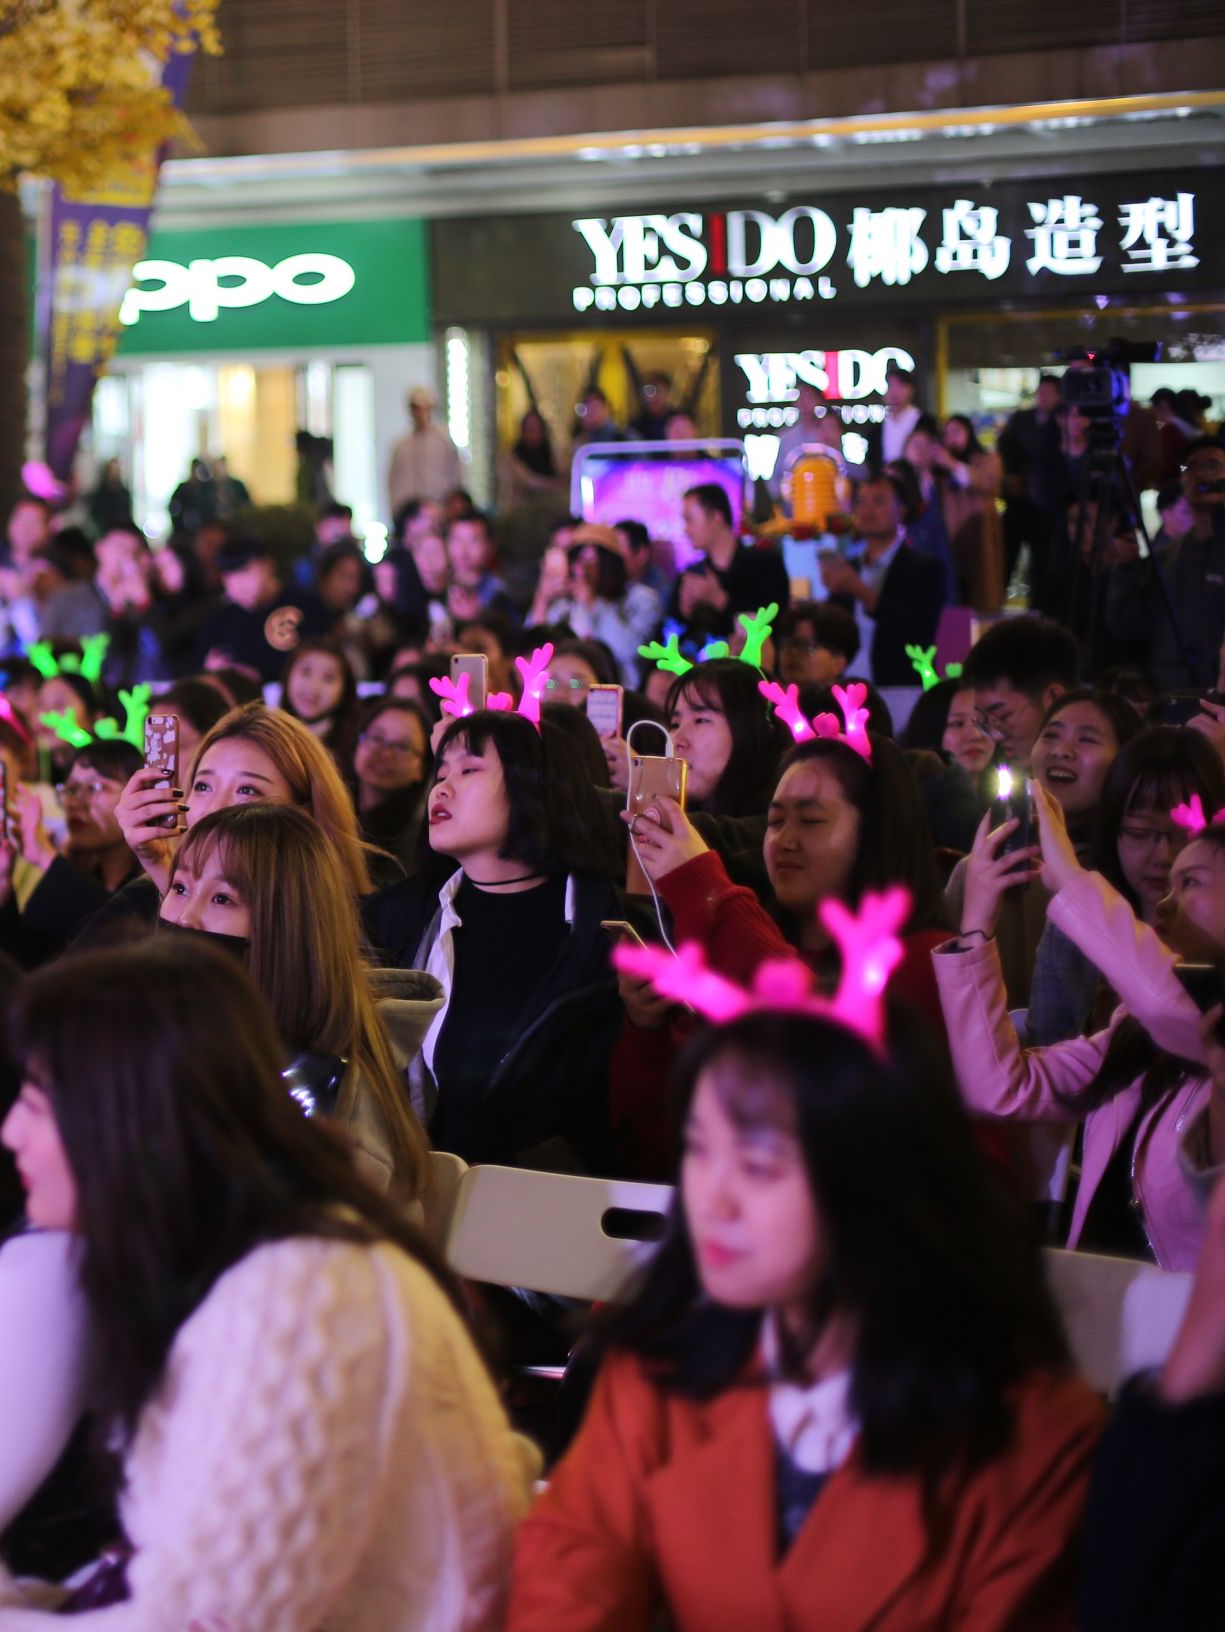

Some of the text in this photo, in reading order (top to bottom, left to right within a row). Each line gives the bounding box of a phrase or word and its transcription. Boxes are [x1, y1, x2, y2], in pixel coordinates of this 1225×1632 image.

[846, 193, 1200, 288] 椰岛造型
[118, 253, 356, 326] ppo
